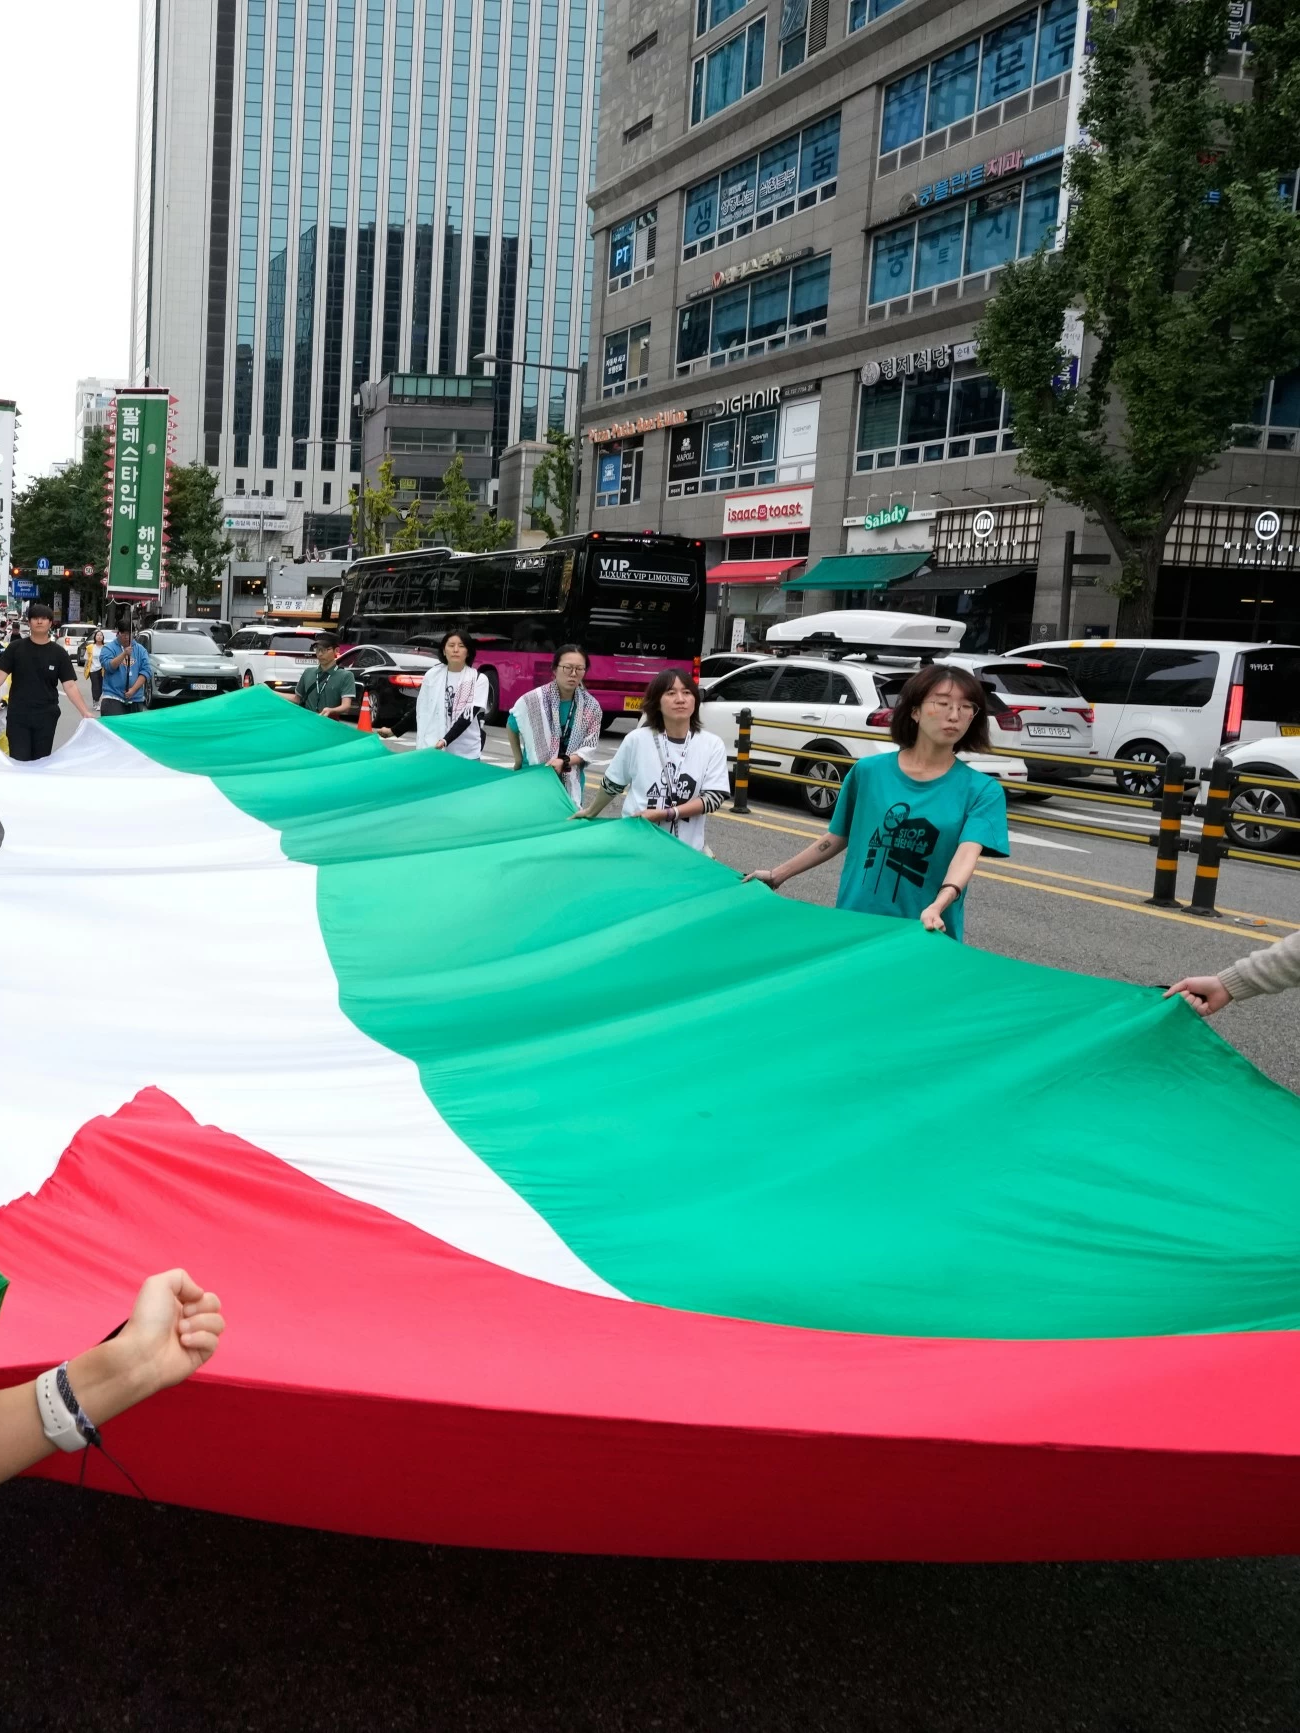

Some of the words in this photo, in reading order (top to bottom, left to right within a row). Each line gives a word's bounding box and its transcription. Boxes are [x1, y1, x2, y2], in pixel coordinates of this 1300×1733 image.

[615, 245, 630, 267] PT
[880, 343, 952, 381] 형제식당
[119, 407, 141, 520] 팔레스타인에
[727, 507, 757, 523] isaac
[767, 501, 805, 519] toast
[864, 505, 908, 531] Salady
[947, 538, 1019, 550] MENCHURU
[136, 525, 156, 581] 해방을
[600, 558, 630, 572] VIP
[1238, 557, 1267, 565] Ramen
[599, 570, 632, 580] LUXURY
[633, 572, 647, 581] VIP
[648, 574, 689, 584] LIMOUSINE
[620, 641, 666, 651] DAEWOO
[1249, 663, 1275, 671] 카카오T
[898, 828, 927, 841] STOP
